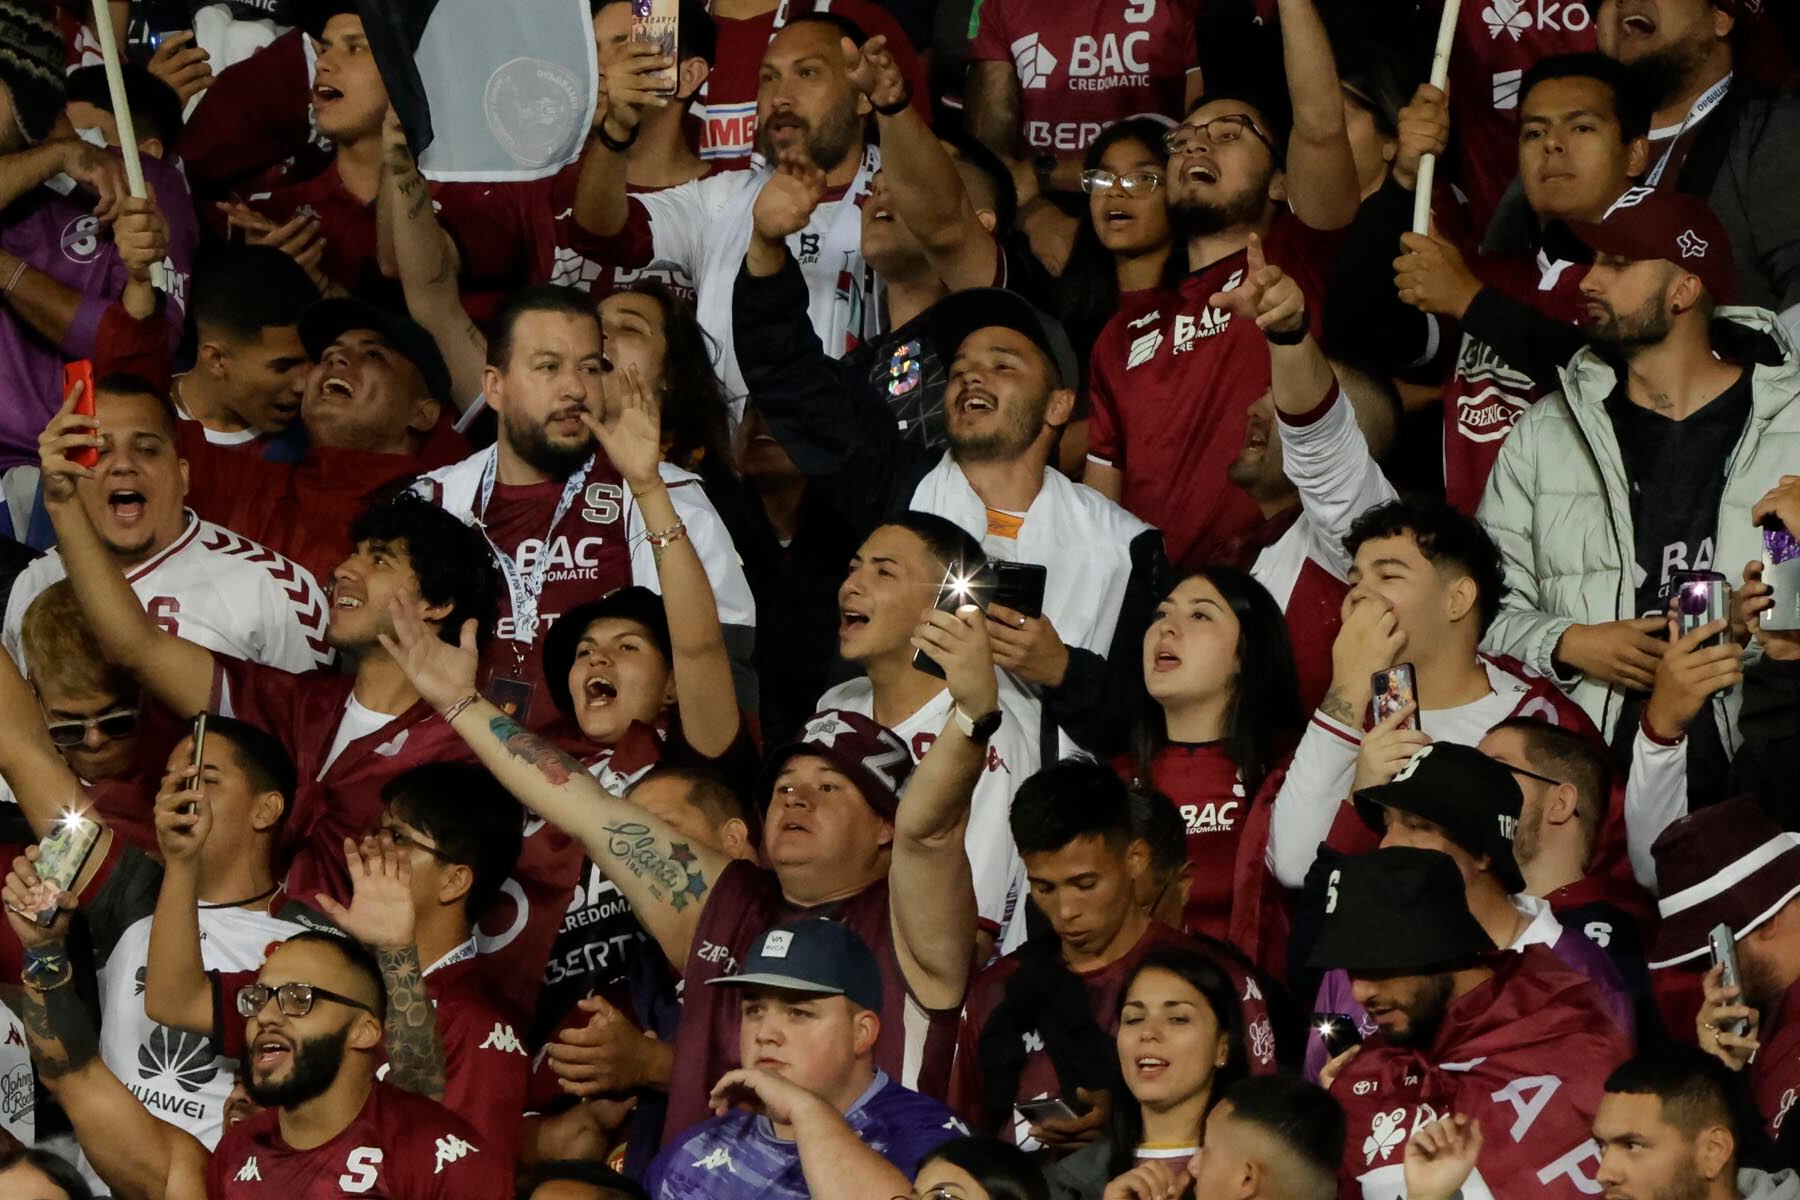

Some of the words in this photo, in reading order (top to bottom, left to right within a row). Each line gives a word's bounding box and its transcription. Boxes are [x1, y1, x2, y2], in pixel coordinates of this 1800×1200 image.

[1067, 31, 1153, 79] BAC
[1067, 72, 1153, 92] CREDOMATIC
[580, 482, 624, 525] S
[515, 536, 604, 577] BAC
[1324, 868, 1342, 915] S
[337, 1145, 386, 1194] S
